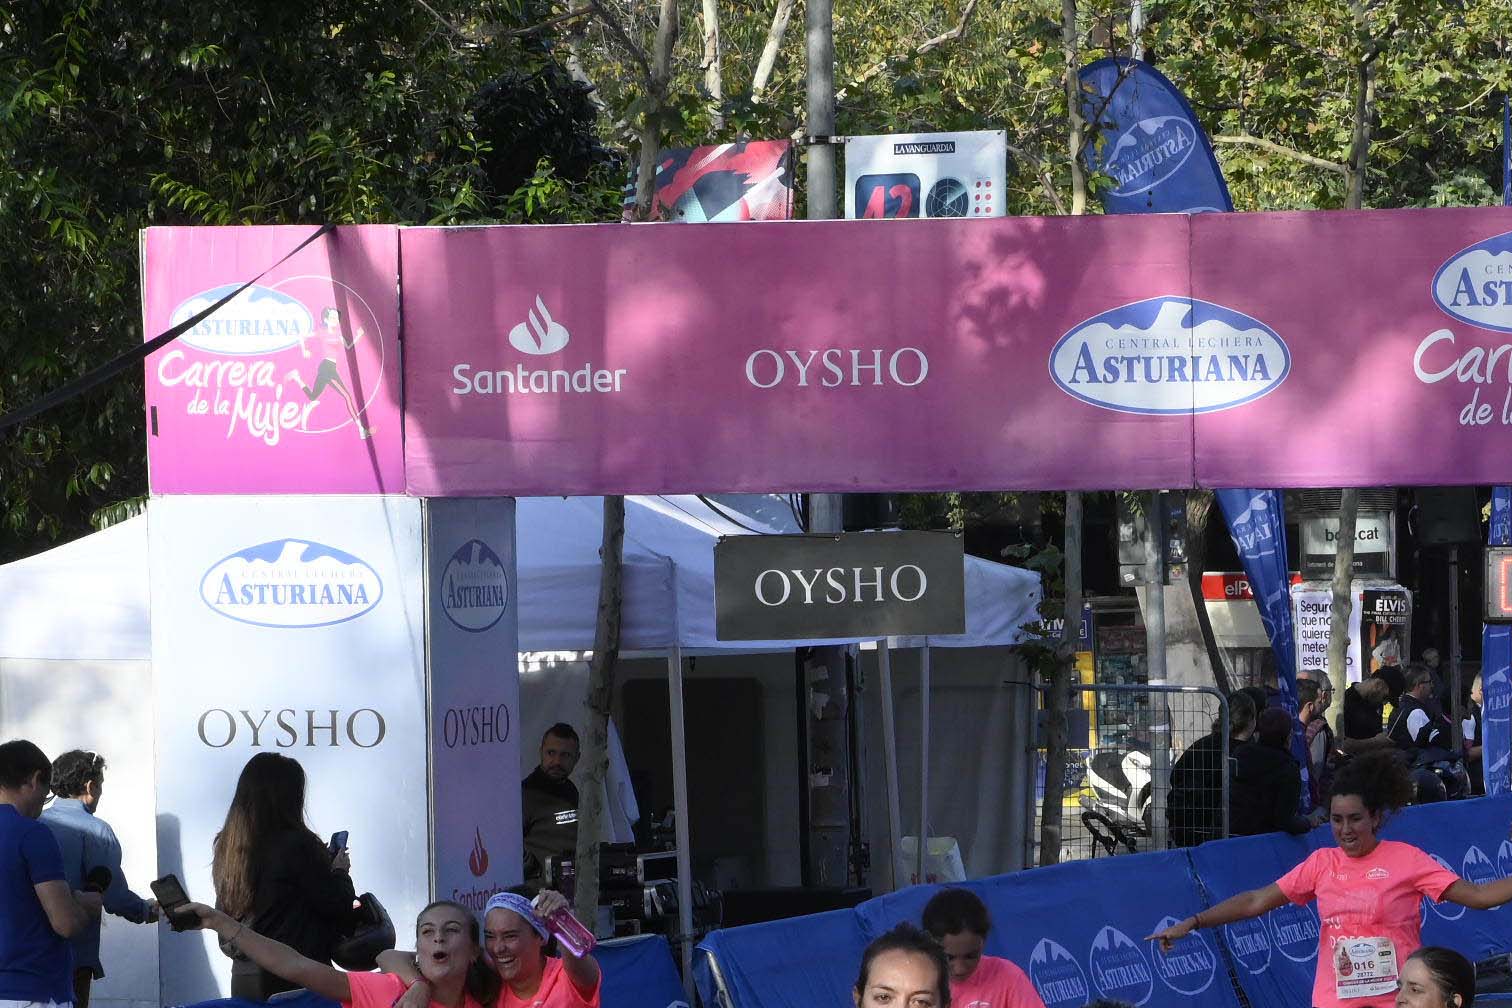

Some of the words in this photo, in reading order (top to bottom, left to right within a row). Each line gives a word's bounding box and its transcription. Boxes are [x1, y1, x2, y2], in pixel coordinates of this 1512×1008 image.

[1105, 337, 1180, 349] CENTRAL
[1188, 336, 1263, 348] LECHERA
[158, 350, 275, 387] Carrera
[453, 363, 627, 394] Santander
[745, 347, 929, 388] OYSHO
[1068, 341, 1272, 384] ASTURIANA
[187, 388, 208, 415] de
[213, 387, 230, 415] la
[226, 384, 320, 446] Mujer
[1459, 387, 1494, 426] de
[214, 571, 370, 605] ASTURIANA
[446, 578, 505, 609] ASTURIANA
[754, 564, 928, 606] OYSHO
[1375, 599, 1406, 612] ELVIS
[197, 708, 386, 748] OYSHO
[443, 703, 510, 749] OYSHO
[1353, 960, 1375, 970] 016
